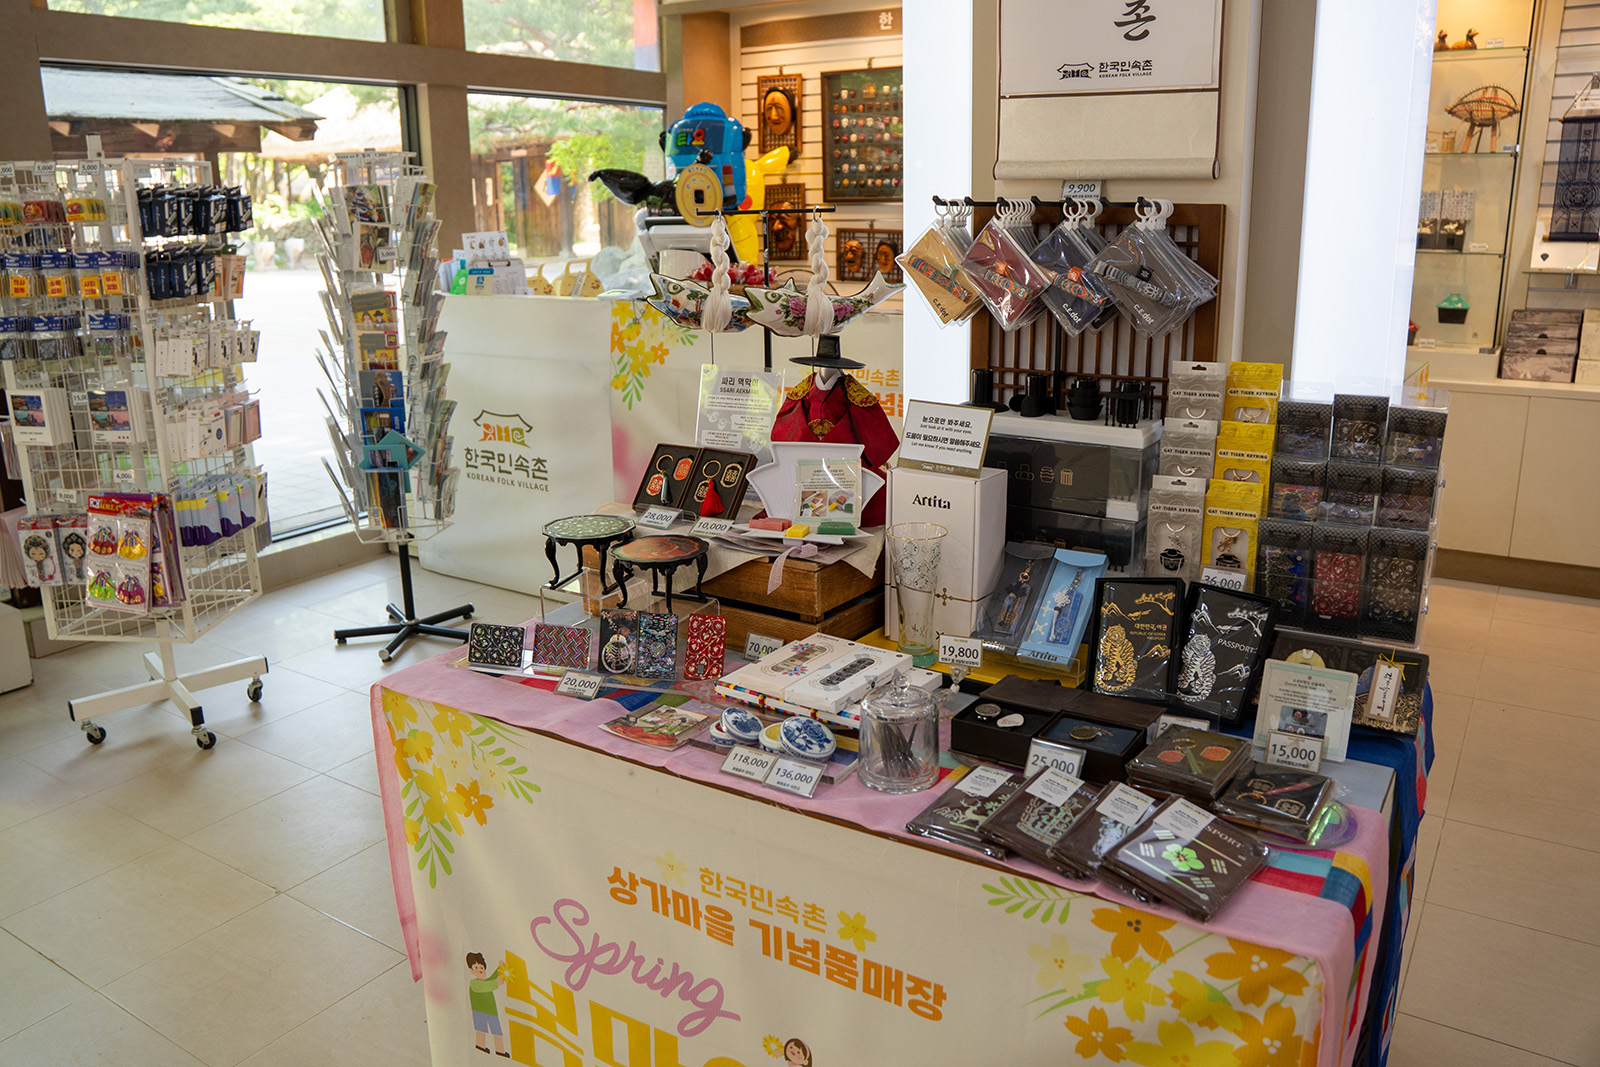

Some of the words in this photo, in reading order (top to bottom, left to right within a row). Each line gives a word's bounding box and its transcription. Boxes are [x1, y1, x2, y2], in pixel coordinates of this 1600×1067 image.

[879, 12, 893, 29] 한
[1099, 60, 1152, 72] 한국민속촌
[677, 129, 705, 146] 타요
[1068, 184, 1096, 193] 9,900
[932, 297, 949, 318] c.E.dot
[1062, 302, 1082, 324] c.E.dot
[1133, 303, 1155, 325] c.E.dot
[922, 416, 946, 425] 눈으로만
[947, 419, 972, 428] 봐주세요.
[905, 432, 922, 440] 도움이
[922, 434, 949, 444] 필요하시면
[949, 436, 981, 449] 말씀해주세요.
[464, 446, 548, 481] 한국민속촌
[466, 472, 495, 484] KOREAN
[497, 476, 516, 487] FOLK
[517, 480, 549, 492] VILLAGE
[912, 494, 951, 509] Artita
[644, 512, 672, 522] 28,000
[697, 521, 727, 531] 10,000
[942, 645, 979, 659] 19,800
[1218, 638, 1255, 654] PASSPORT
[1028, 649, 1058, 662] Artita
[564, 677, 597, 689] 20,000
[732, 753, 768, 769] 118,000
[1272, 744, 1316, 761] 15,000
[1031, 754, 1075, 774] 25000
[775, 767, 813, 784] 136,000
[699, 867, 827, 934] 한국민속촌
[607, 866, 735, 947] 상가마을
[749, 918, 947, 1022] 기념품매장
[530, 898, 742, 1038] Spring
